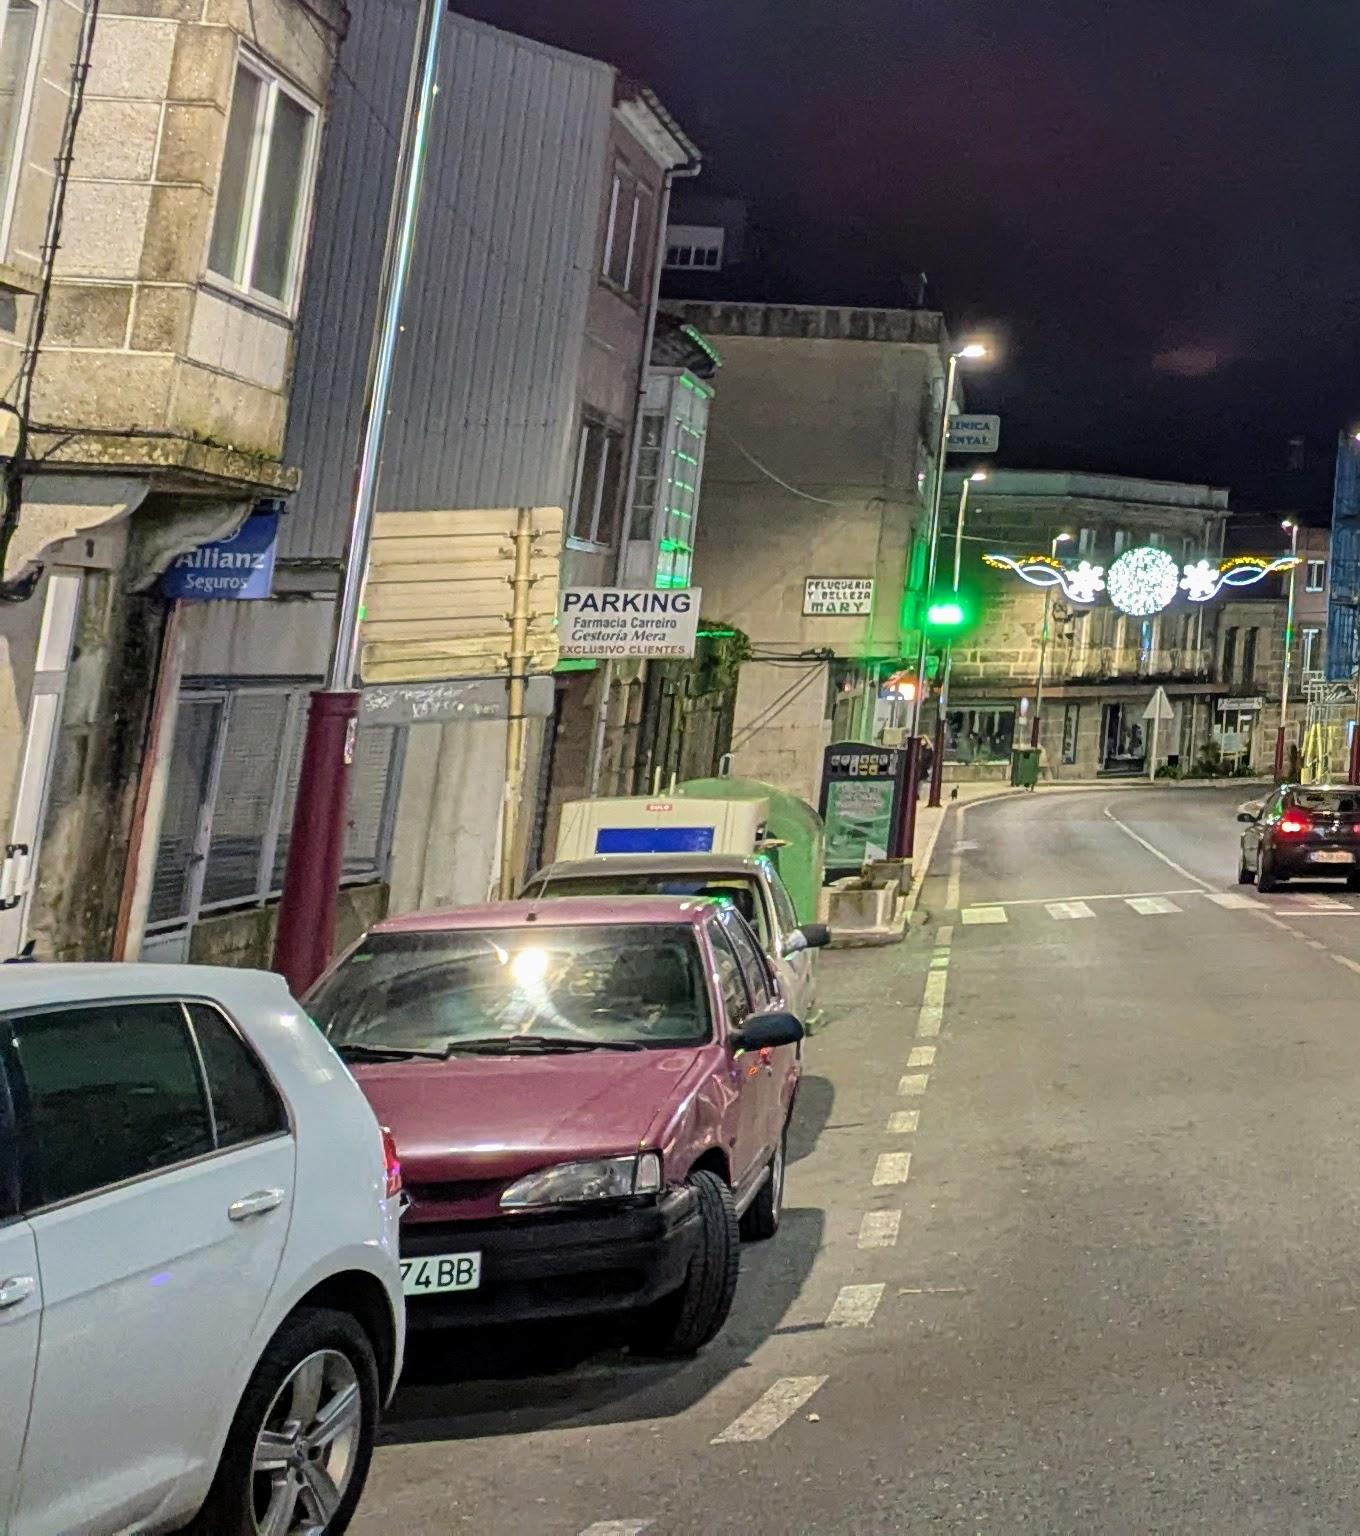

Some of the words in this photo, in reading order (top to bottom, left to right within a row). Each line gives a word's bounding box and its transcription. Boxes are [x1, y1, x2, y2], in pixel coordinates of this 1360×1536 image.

[950, 421, 990, 431] LINICA
[175, 548, 265, 569] Allianz
[185, 573, 248, 593] Seguros
[808, 591, 814, 599] Y
[822, 591, 871, 600] BELLEZA
[563, 592, 691, 613] PARKING
[574, 617, 627, 629] Farmacia
[631, 617, 677, 629] Carreiro
[630, 630, 667, 642] Mera
[559, 645, 625, 654] EXCLUSIVO
[629, 645, 685, 654] CLIENTES
